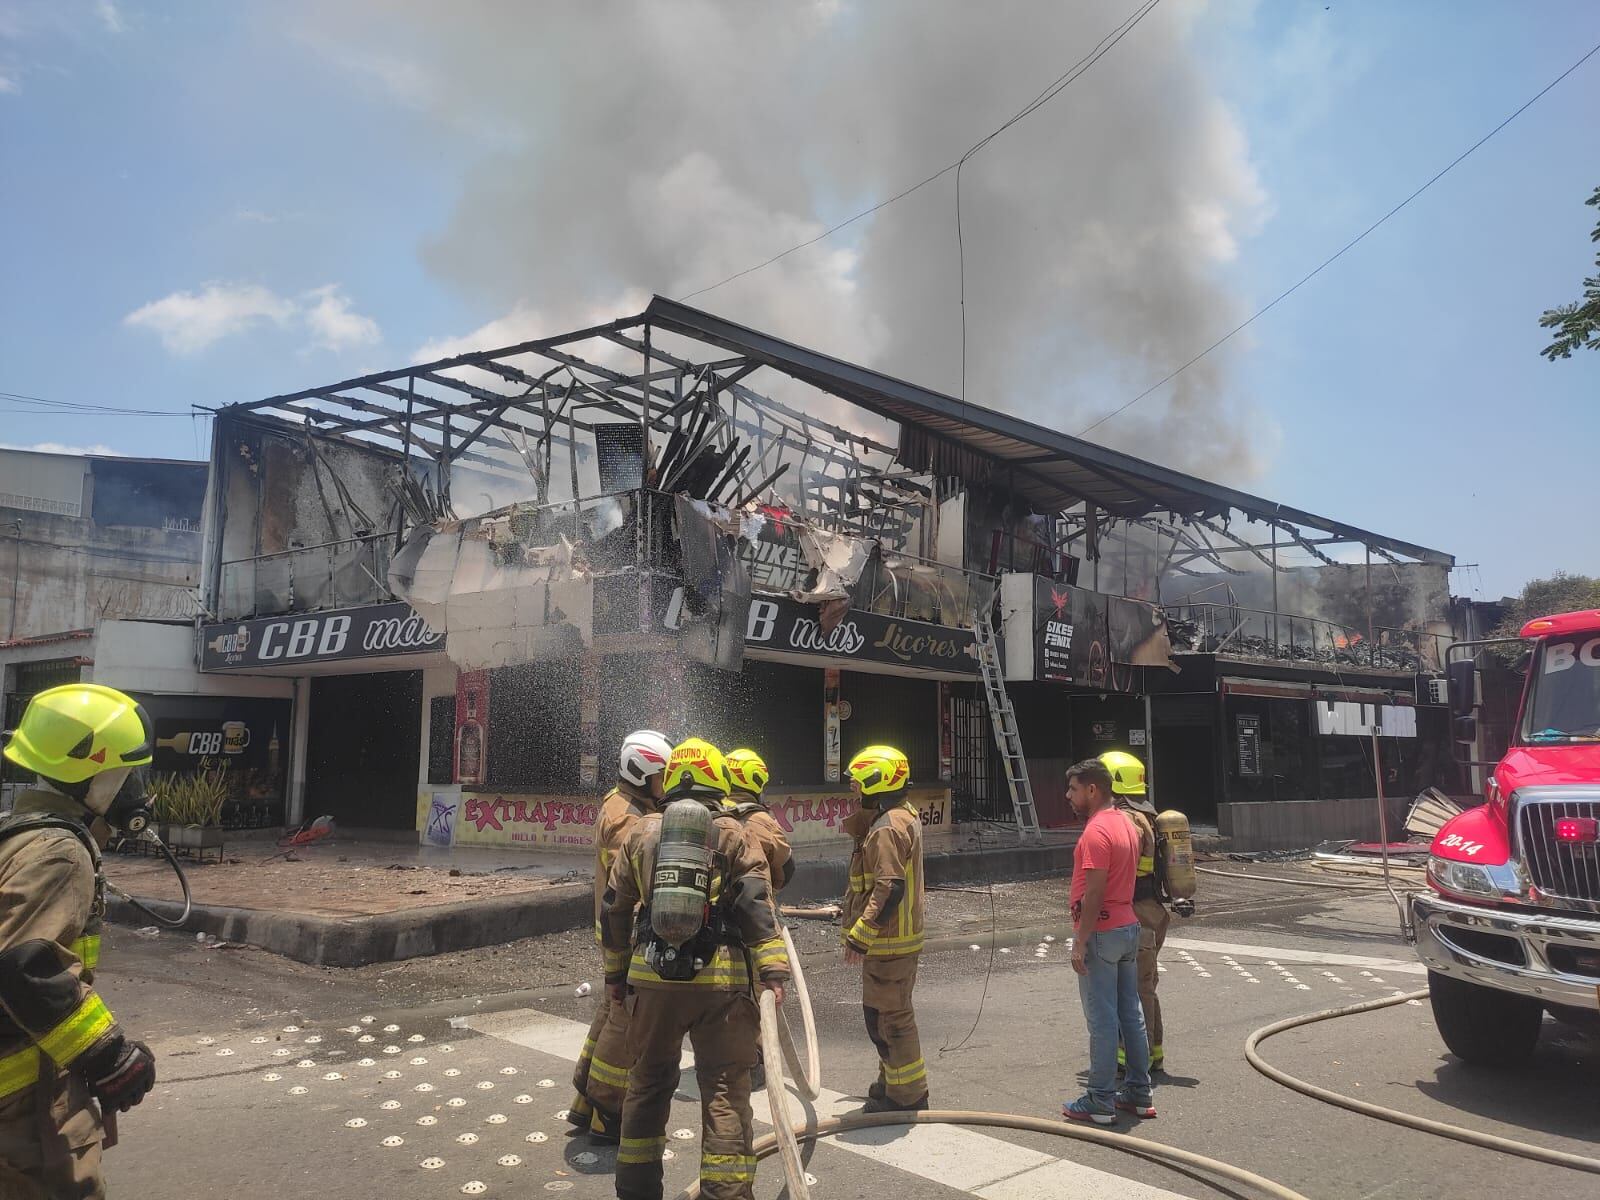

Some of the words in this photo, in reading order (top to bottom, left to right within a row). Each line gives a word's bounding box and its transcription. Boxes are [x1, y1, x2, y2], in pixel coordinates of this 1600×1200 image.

[258, 615, 352, 660] CBB
[1044, 632, 1072, 649] FENIX
[1046, 620, 1074, 637] BIKES
[873, 623, 960, 661] Licores
[188, 732, 222, 754] CBB
[465, 796, 599, 833] EXTRAFRIO
[919, 802, 945, 826] istal
